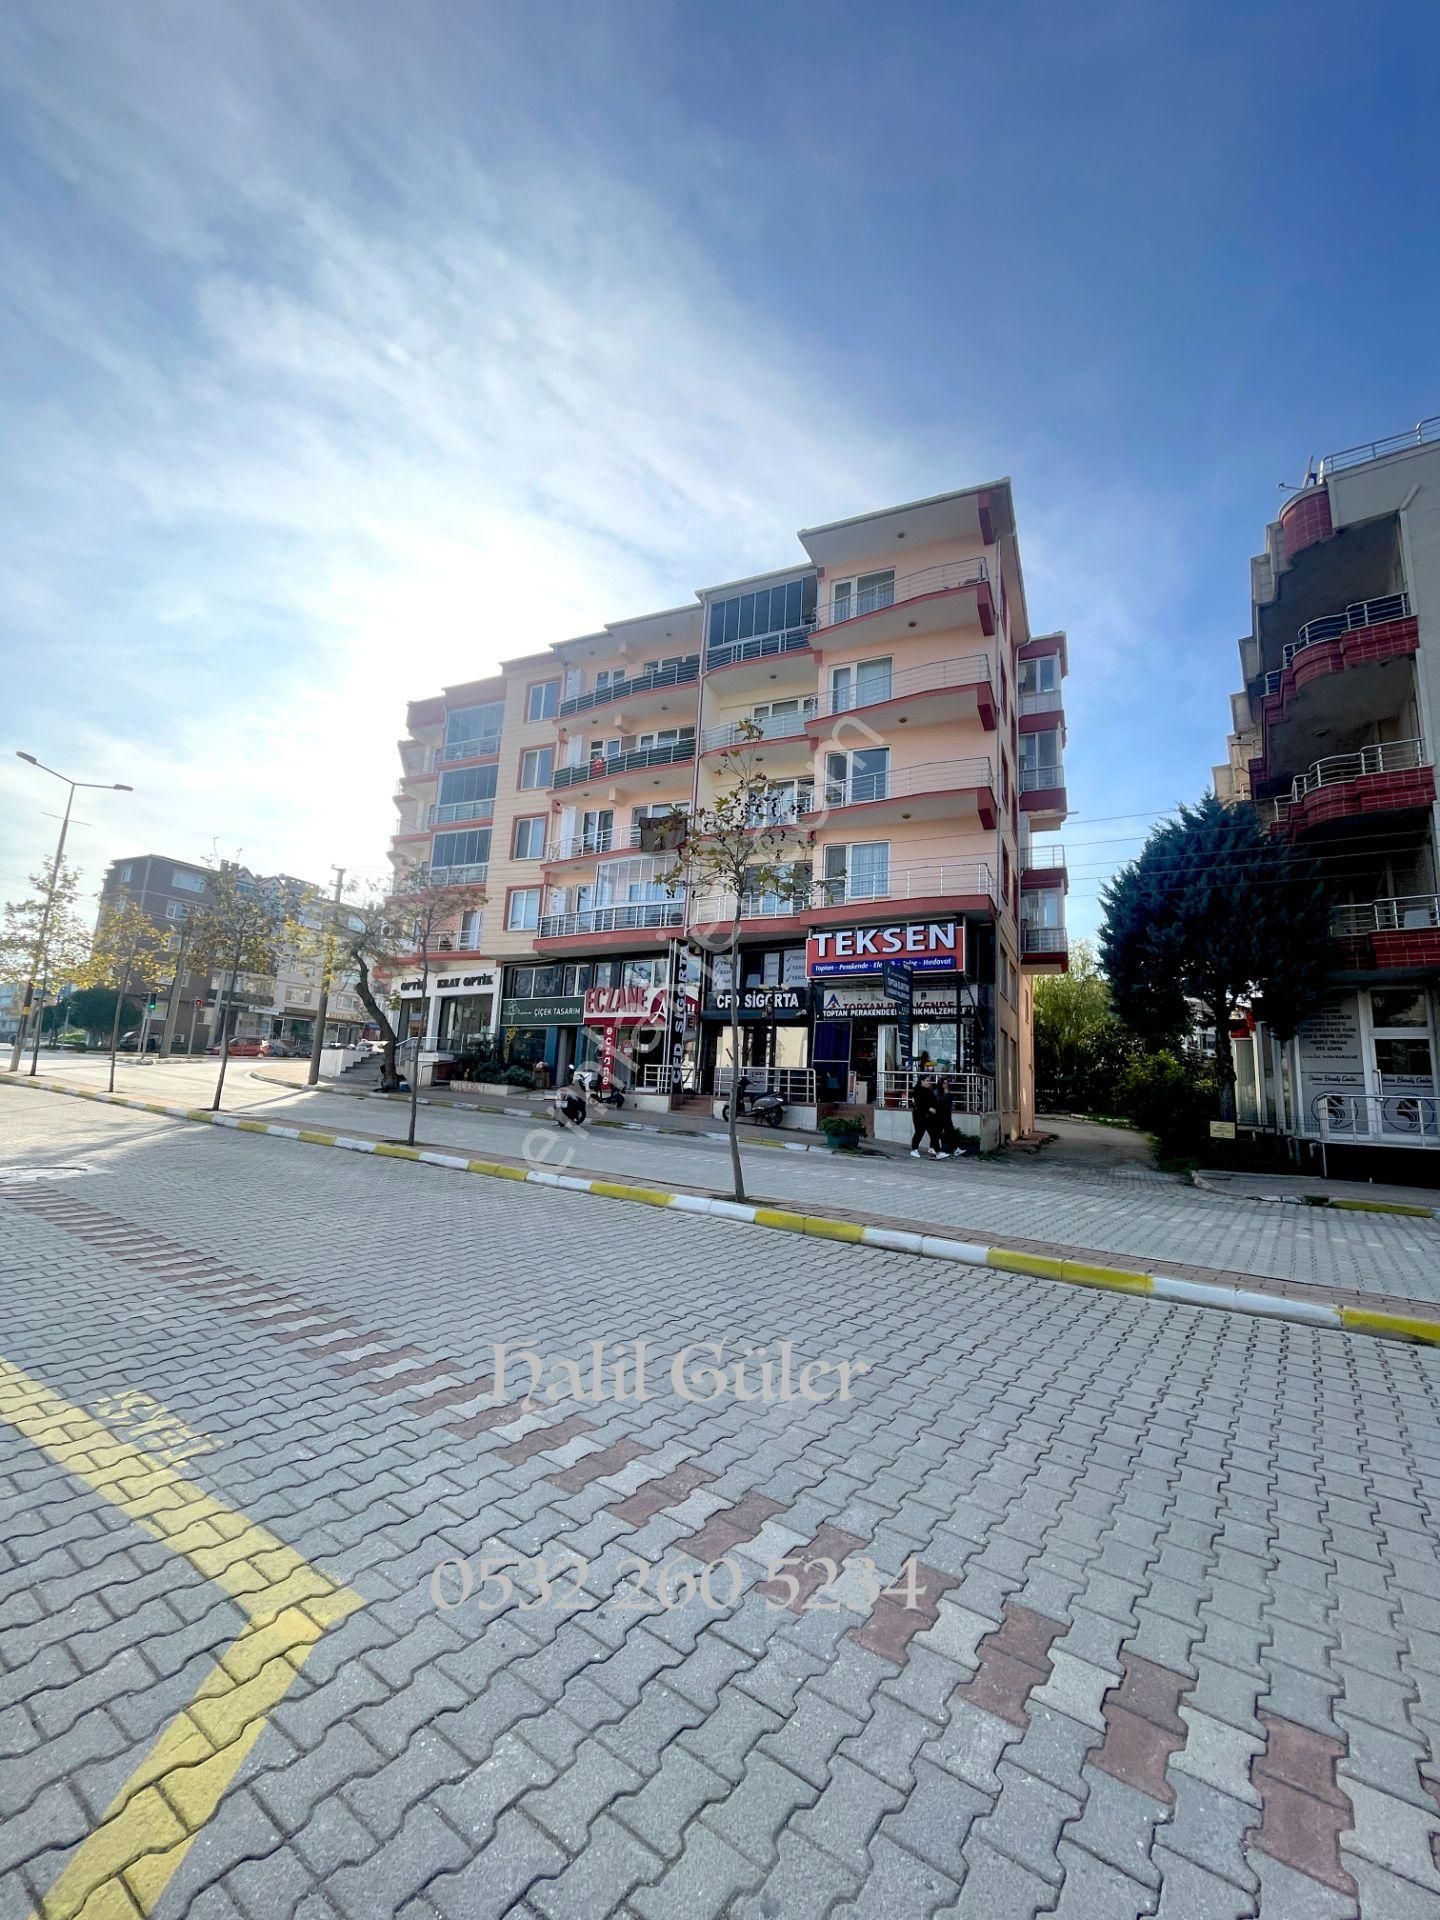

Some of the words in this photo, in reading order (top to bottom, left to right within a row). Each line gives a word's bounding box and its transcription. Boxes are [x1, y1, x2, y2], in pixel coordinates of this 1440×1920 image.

[812, 922, 955, 957] TEKSEN
[815, 965, 834, 973] Toptan
[839, 962, 868, 971] Perakende
[585, 986, 648, 1013] ECZANE
[534, 1007, 552, 1018] ÇİÇEK
[553, 1007, 580, 1016] TASARIM
[823, 1009, 848, 1017] TOPTAN
[850, 1008, 889, 1017] PERAKENDE
[602, 1027, 613, 1084] eczane
